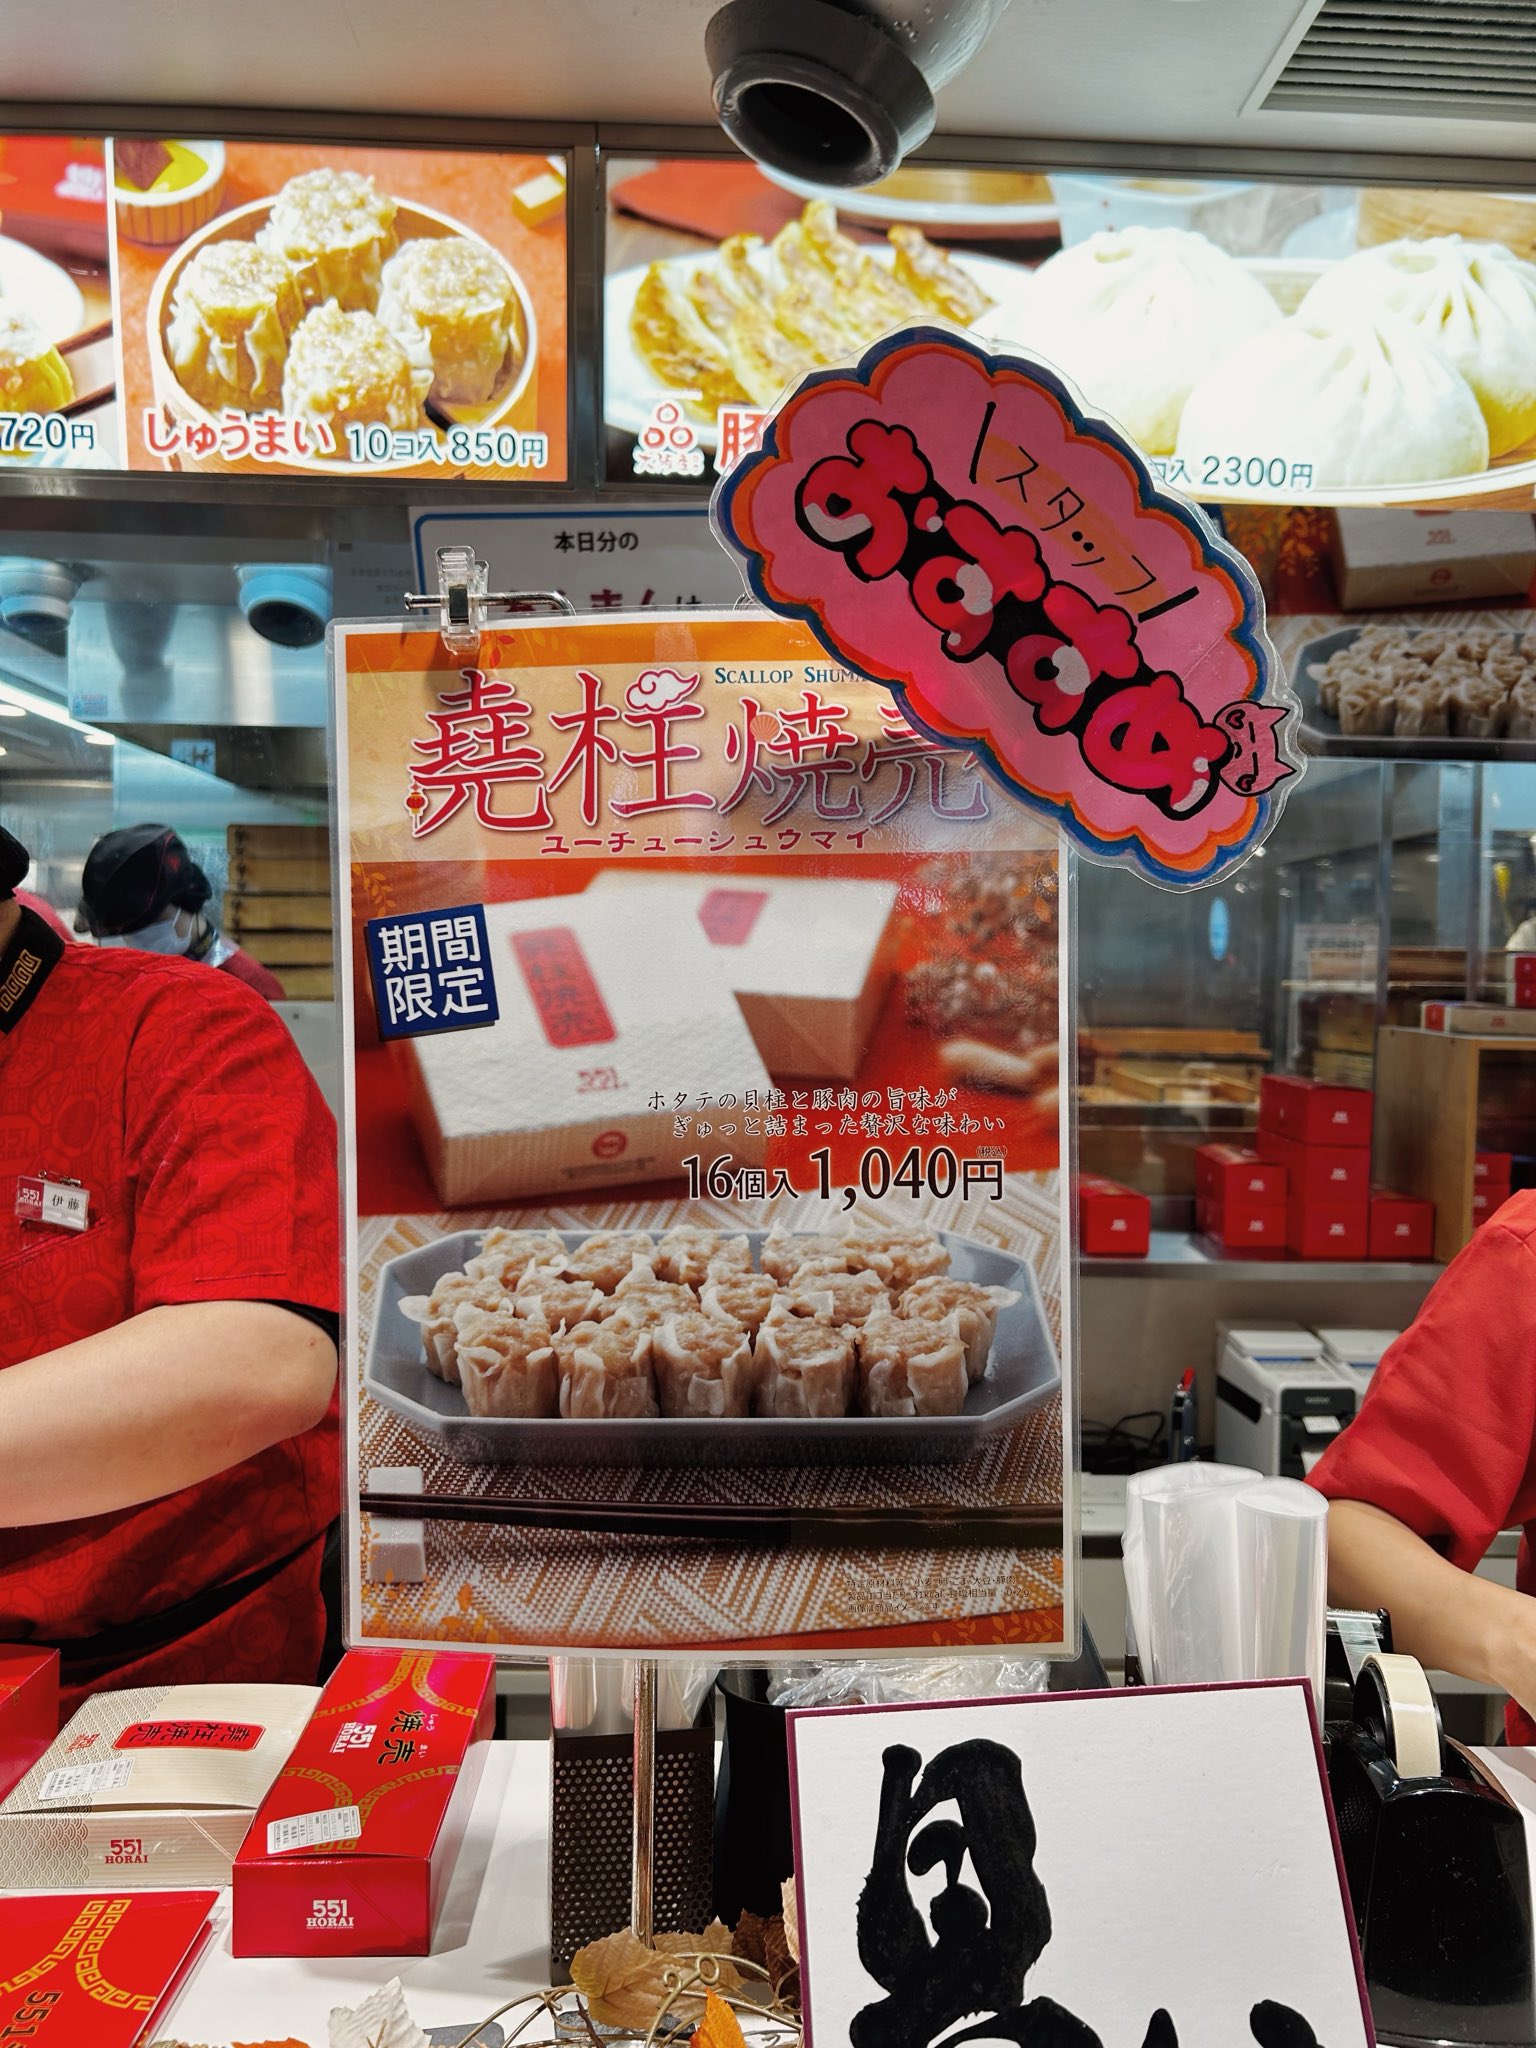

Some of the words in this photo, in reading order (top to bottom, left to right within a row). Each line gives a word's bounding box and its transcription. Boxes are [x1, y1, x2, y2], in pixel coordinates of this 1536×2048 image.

[0, 417, 94, 450] 720円
[147, 412, 331, 457] しゅうまい
[350, 428, 442, 461] 10コ入
[451, 431, 544, 465] 850円
[1201, 454, 1313, 489] 2300円
[995, 445, 1158, 597] スタッフ
[553, 531, 639, 553] 本日分の
[795, 418, 1232, 821] おすすめ
[714, 667, 794, 684] SCALLOP
[539, 828, 867, 856] ユーチューシュウマイ
[378, 914, 482, 975] 期間
[385, 965, 489, 1025] 限定
[646, 1086, 959, 1112] ホタテの貝柱と豚肉の旨味が
[671, 1114, 1007, 1138] ぎゅっと詰まった贅沢な味わい
[681, 1154, 799, 1201] 16個入
[809, 1146, 1005, 1211] 1,040円
[332, 1721, 357, 1754] HORAI
[346, 1723, 378, 1749] 551
[377, 1709, 427, 1765] 焼売
[105, 1855, 149, 1864] HORAI
[110, 1839, 142, 1855] 551
[305, 1917, 355, 1927] HORAI
[312, 1899, 348, 1918] 551
